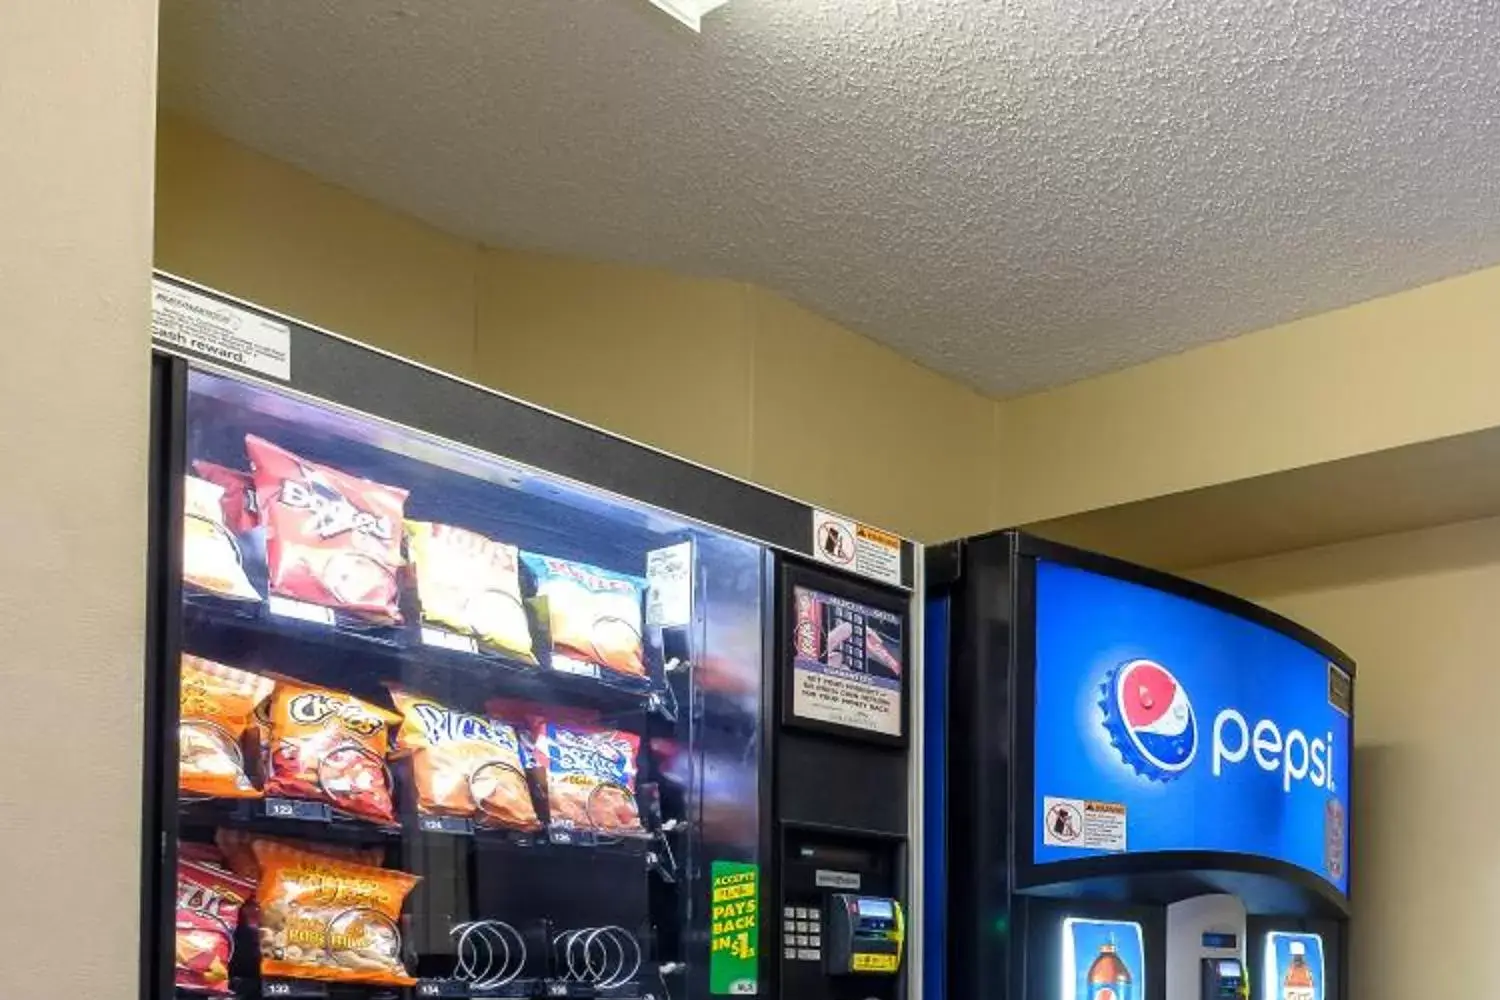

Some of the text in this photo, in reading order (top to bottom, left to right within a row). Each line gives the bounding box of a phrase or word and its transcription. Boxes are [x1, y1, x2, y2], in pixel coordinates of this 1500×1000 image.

[869, 703, 889, 713] BACK
[1212, 708, 1334, 792] pepsi
[273, 804, 293, 816] 122
[713, 900, 755, 920] PAYS
[713, 916, 755, 935] BACK
[712, 936, 731, 952] IN
